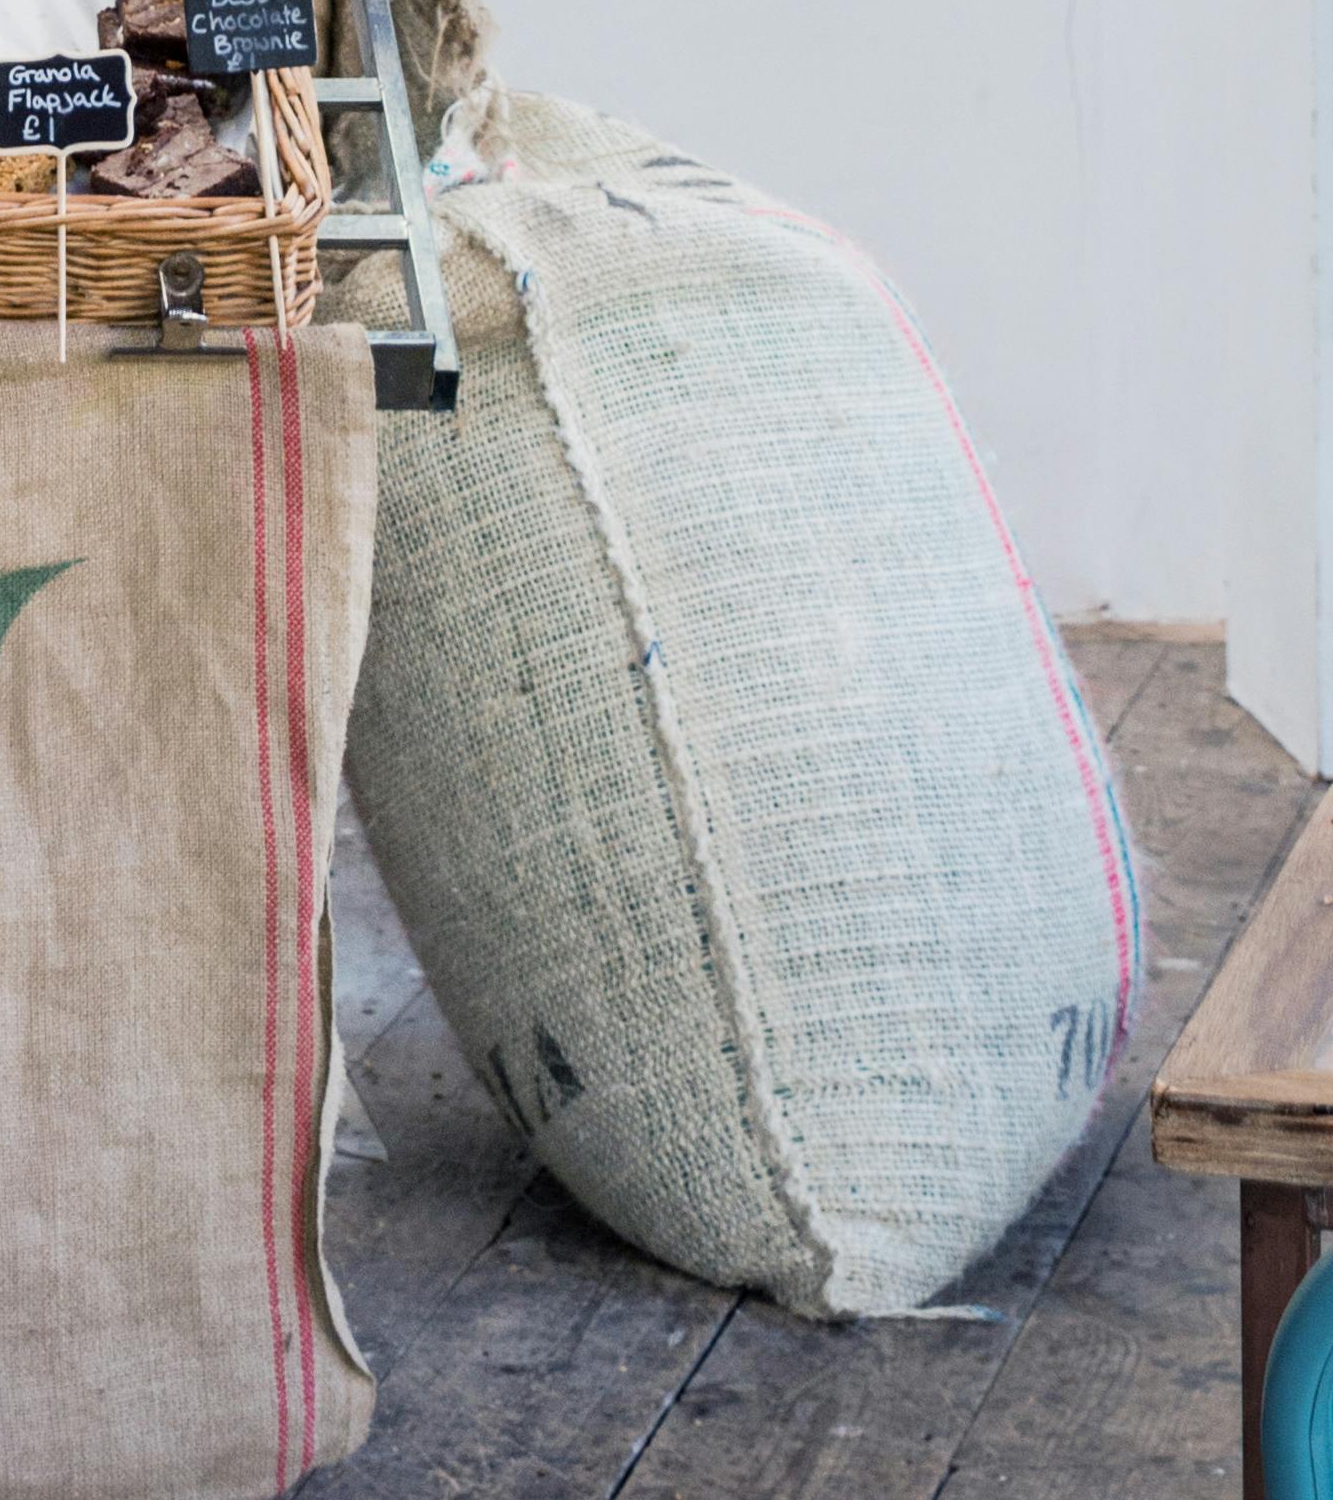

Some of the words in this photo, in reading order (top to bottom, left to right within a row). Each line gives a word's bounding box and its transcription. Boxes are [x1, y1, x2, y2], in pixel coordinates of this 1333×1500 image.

[213, 28, 310, 56] Brownie
[8, 61, 101, 86] Granola
[21, 114, 56, 143] £1
